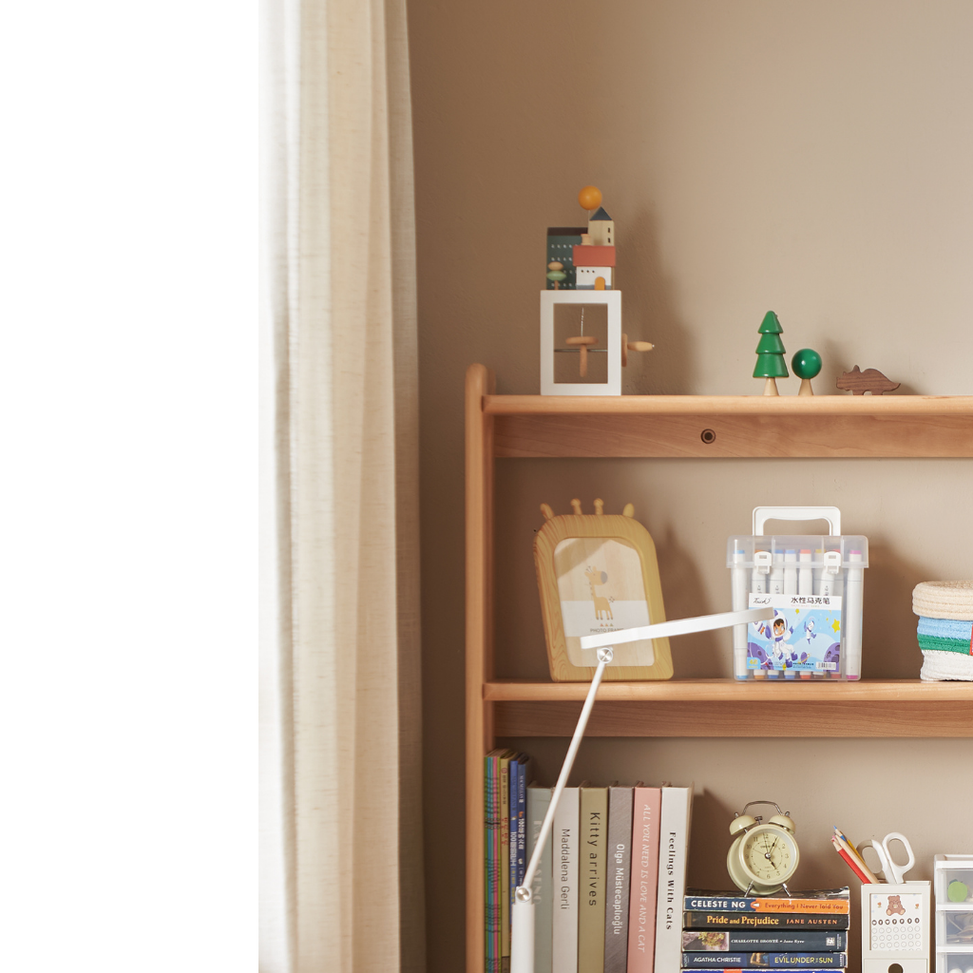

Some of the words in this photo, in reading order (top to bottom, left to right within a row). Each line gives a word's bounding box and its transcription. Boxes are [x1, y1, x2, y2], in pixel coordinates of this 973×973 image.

[790, 597, 831, 605] 水性马克笔
[643, 804, 651, 821] ALL
[587, 812, 600, 847] Kitty
[560, 828, 571, 882] Maddalena
[614, 843, 626, 864] Olga
[641, 845, 649, 867] NEED
[666, 832, 677, 876] Feelings
[589, 852, 600, 906] arrives
[560, 886, 570, 910] Gerli
[640, 880, 648, 902] LOVE
[667, 880, 675, 903] With
[639, 904, 647, 925] AND
[691, 900, 728, 908] CELESTE
[731, 901, 746, 909] NG
[764, 902, 796, 911] Everything
[666, 907, 674, 930] Cats
[706, 915, 729, 925] Pride
[741, 916, 780, 927] Prejudice
[637, 936, 645, 953] CAT
[774, 956, 790, 964] EVIL
[790, 956, 814, 964] UNDER
